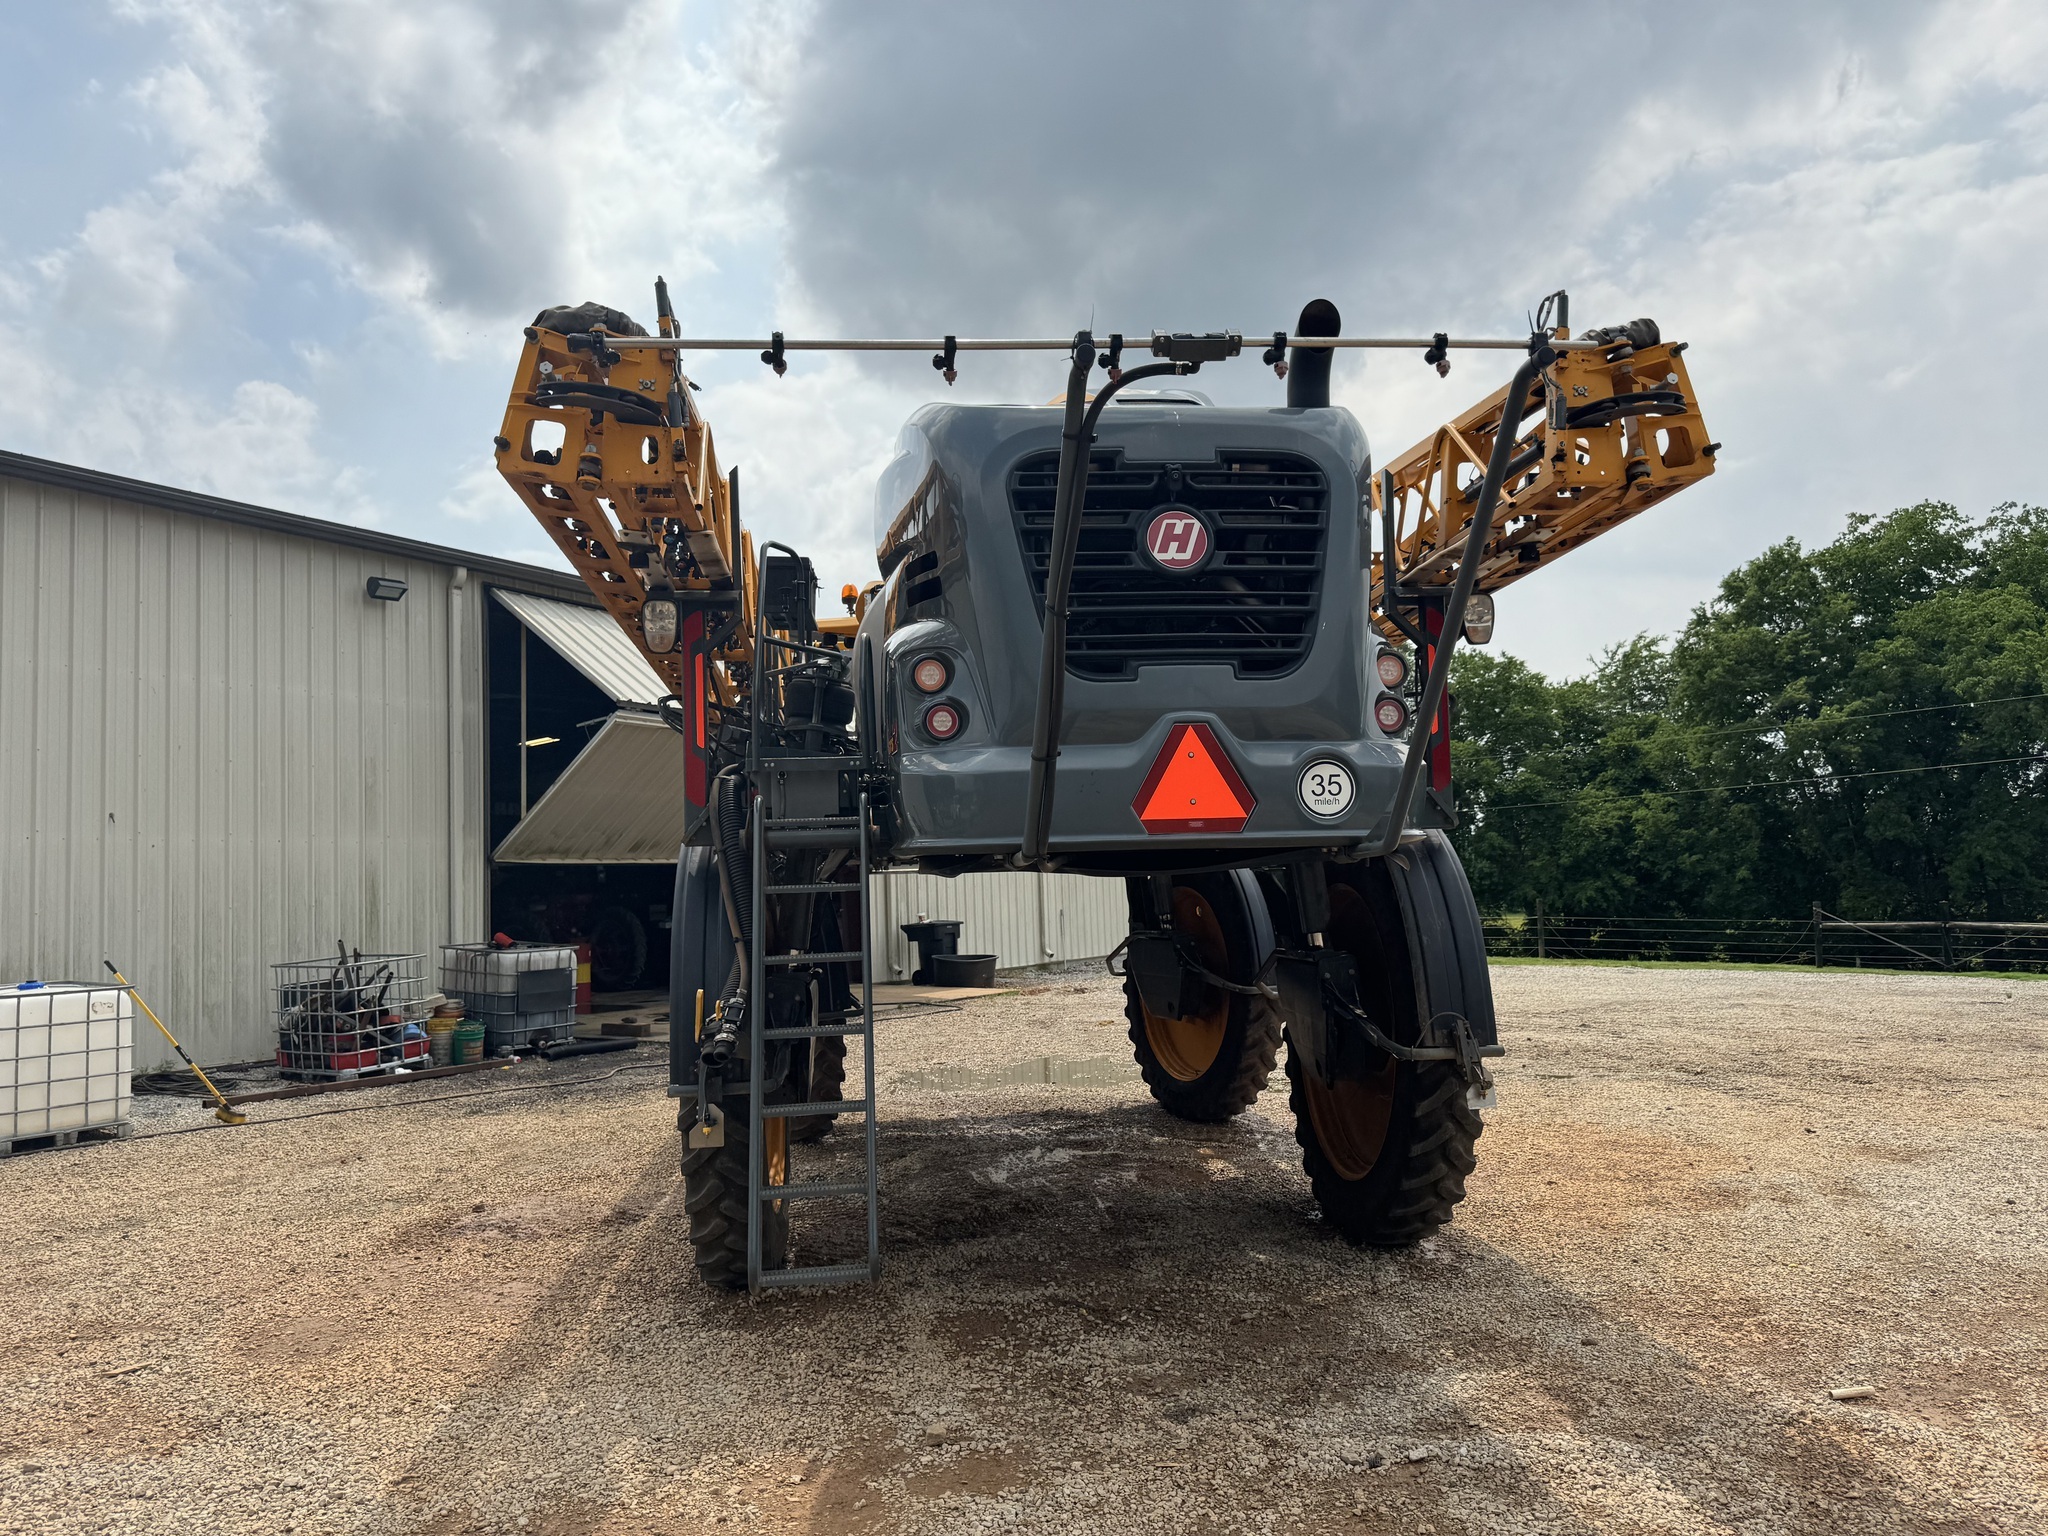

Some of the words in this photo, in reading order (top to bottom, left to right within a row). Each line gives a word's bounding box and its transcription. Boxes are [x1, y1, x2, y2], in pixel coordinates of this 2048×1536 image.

[1153, 519, 1201, 560] H
[1310, 774, 1342, 797] 35
[1314, 797, 1340, 806] mile/h
